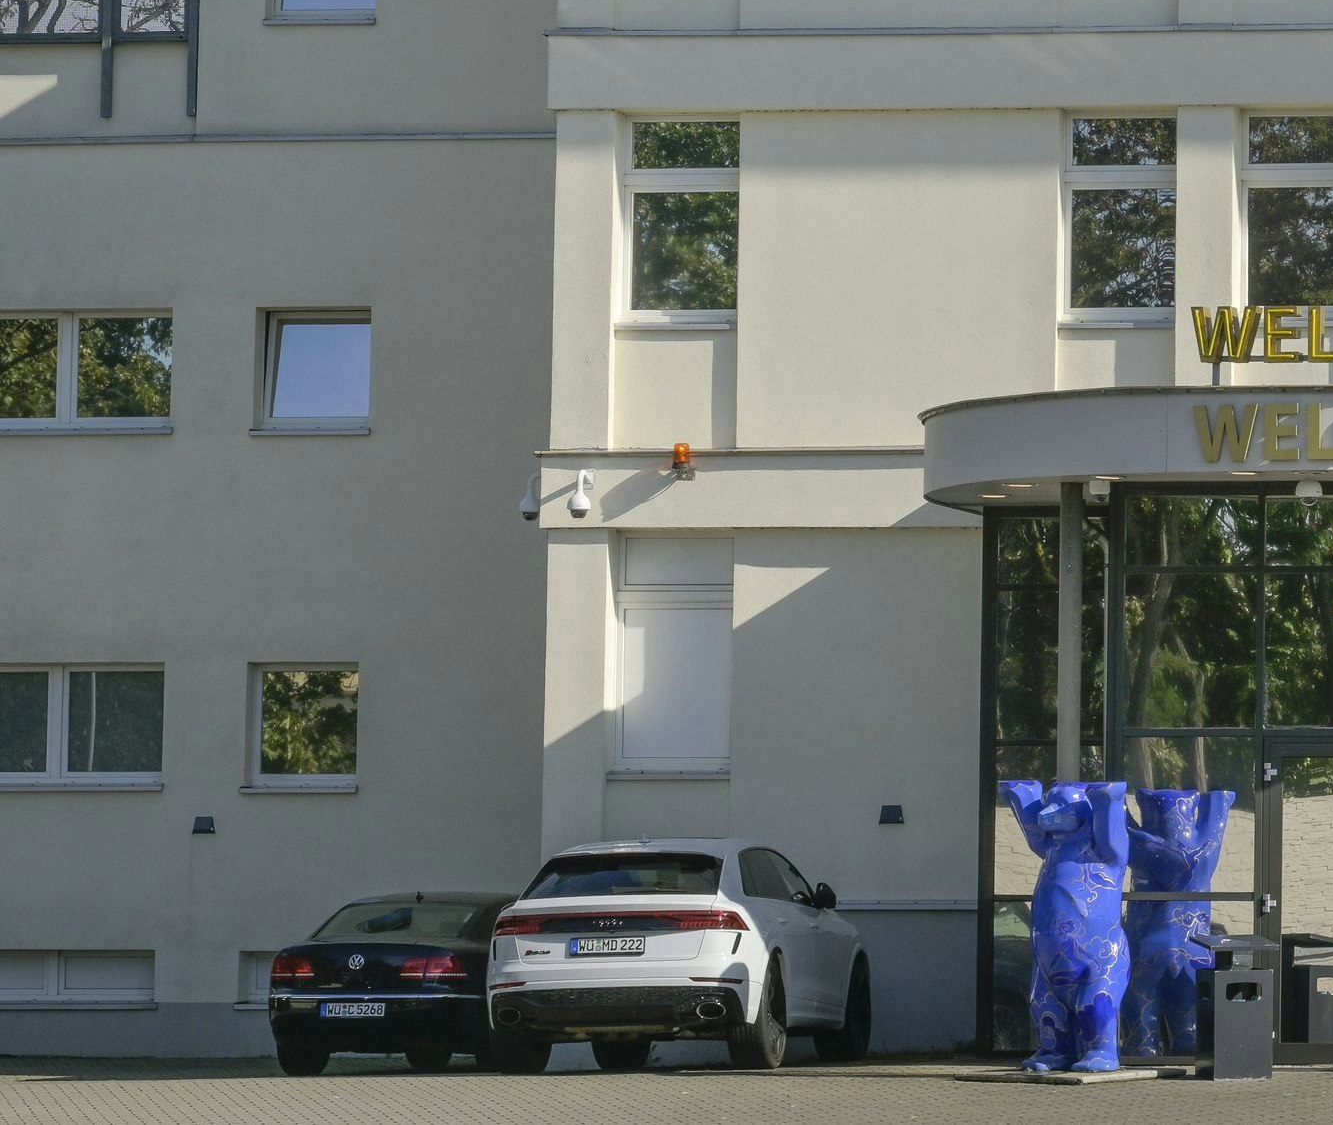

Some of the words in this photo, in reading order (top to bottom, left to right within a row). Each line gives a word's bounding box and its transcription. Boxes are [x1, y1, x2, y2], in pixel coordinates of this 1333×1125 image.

[579, 939, 594, 952] WÜ
[602, 939, 617, 951] MD
[620, 939, 642, 951] 222
[347, 1004, 354, 1015] C
[356, 1004, 383, 1015] 5268
